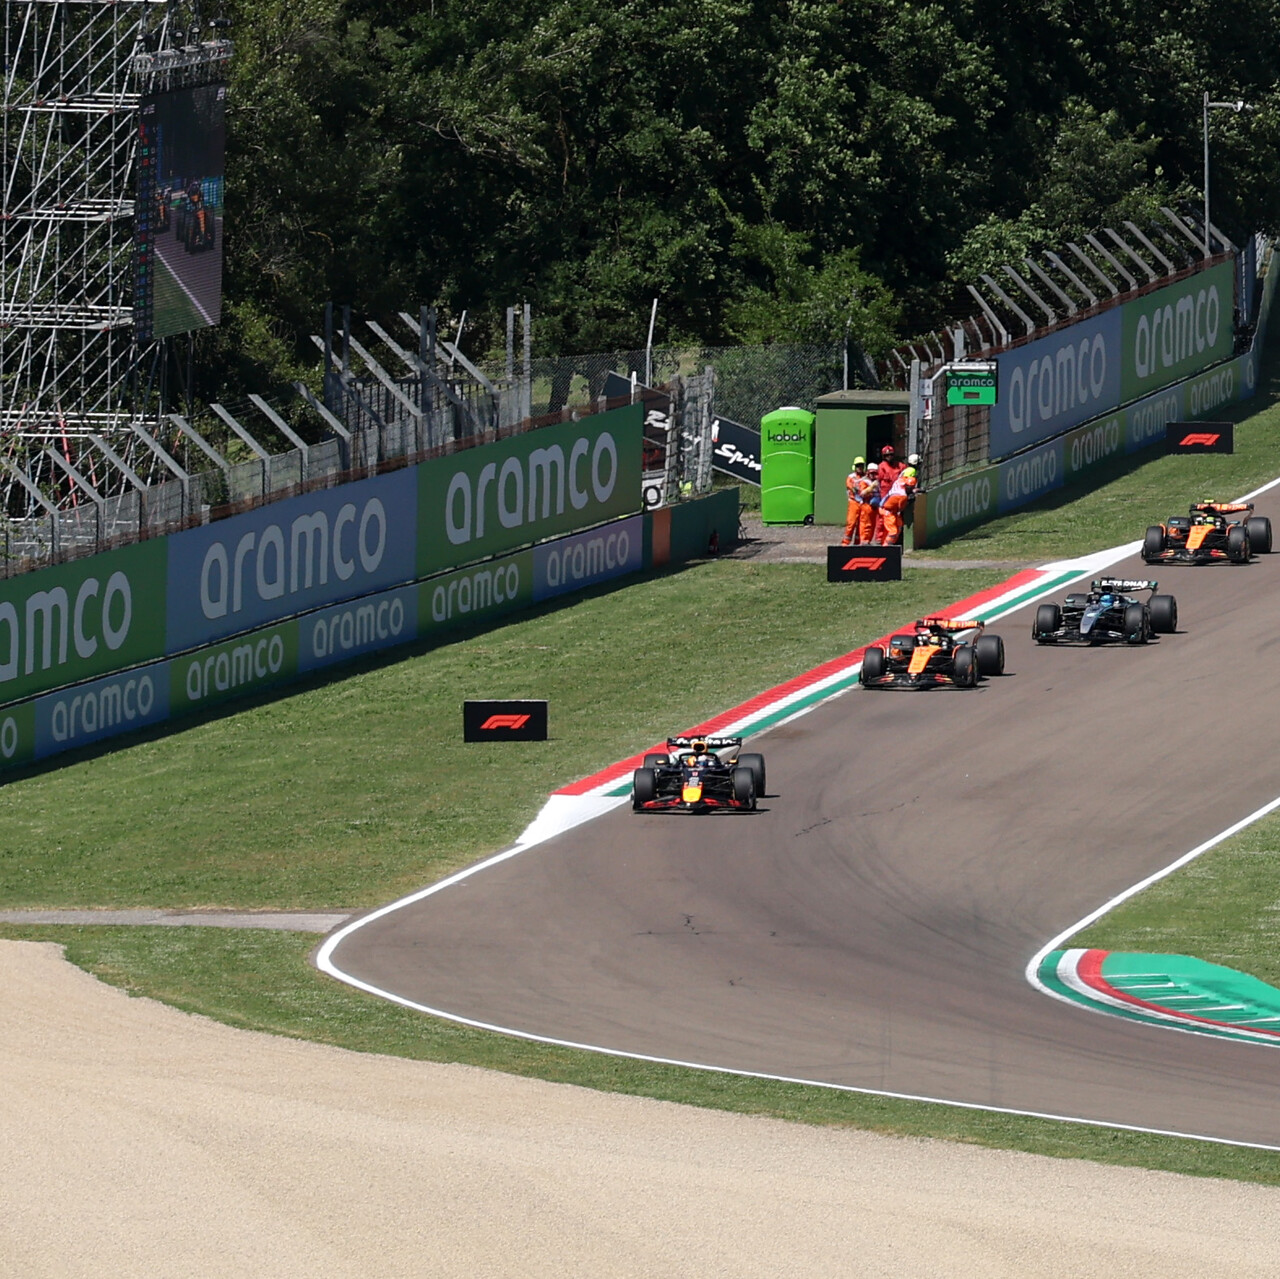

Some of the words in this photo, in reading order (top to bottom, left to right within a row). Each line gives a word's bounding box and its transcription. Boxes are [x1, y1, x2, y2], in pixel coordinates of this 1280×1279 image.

[1135, 285, 1219, 378] aramco
[950, 378, 994, 386] aramco
[1008, 333, 1106, 433] aramco
[1190, 368, 1233, 415] aramco
[767, 429, 807, 442] kobak
[1071, 419, 1119, 471] aramco
[445, 432, 618, 545] aramco
[935, 477, 990, 528] aramco
[1007, 448, 1056, 500] aramco
[200, 496, 386, 619] aramco
[546, 530, 629, 587] aramco
[432, 562, 519, 622] aramco
[0, 571, 132, 682] amco
[312, 597, 404, 658] aramco
[186, 634, 283, 700] aramco
[52, 675, 154, 742] aramco
